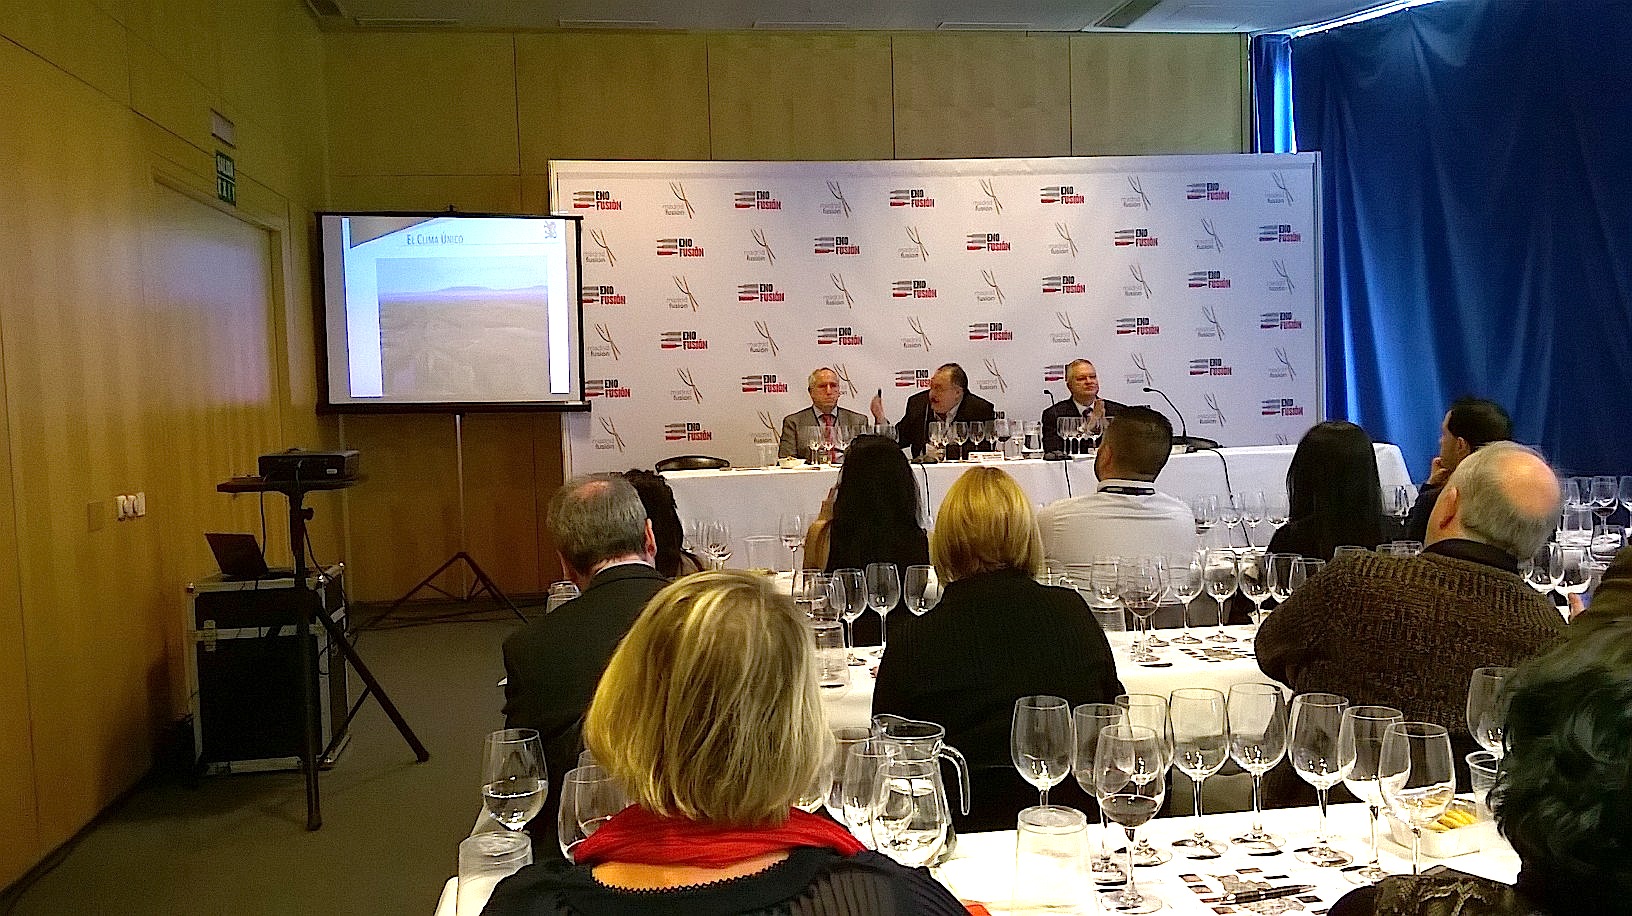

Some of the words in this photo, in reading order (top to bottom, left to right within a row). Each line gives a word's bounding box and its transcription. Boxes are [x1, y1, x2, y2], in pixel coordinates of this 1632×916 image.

[1061, 187, 1074, 195] ENO
[1207, 183, 1219, 191] ENO
[596, 191, 610, 200] ENO
[757, 191, 770, 200] ENO
[911, 190, 924, 198] ENO
[1207, 190, 1230, 200] FUSIÓN
[911, 197, 934, 208] FUSIÓN
[1061, 194, 1084, 204] FUSIÓN
[596, 199, 622, 210] FUSIÓN
[757, 199, 781, 210] FUSIÓN
[1136, 229, 1148, 237] ENO
[1279, 225, 1291, 233] ENO
[836, 237, 849, 245] ENO
[987, 234, 1000, 242] ENO
[1279, 232, 1301, 242] FUSIÓN
[679, 239, 693, 247] ENO
[987, 241, 1011, 251] FUSIÓN
[1136, 237, 1158, 247] FUSIÓN
[680, 246, 704, 257] FUSIÓN
[836, 244, 860, 254] FUSIÓN
[1208, 271, 1220, 279] ENO
[1063, 276, 1075, 284] ENO
[1208, 278, 1231, 288] FUSIÓN
[760, 284, 773, 292] ENO
[913, 281, 926, 289] ENO
[1063, 283, 1086, 294] FUSIÓN
[600, 286, 614, 295] ENO
[914, 288, 937, 298] FUSIÓN
[600, 294, 626, 305] FUSIÓN
[760, 291, 785, 302] FUSIÓN
[1280, 312, 1292, 320] ENO
[1137, 318, 1149, 326] ENO
[1280, 320, 1301, 329] FUSIÓN
[990, 323, 1003, 331] ENO
[1136, 325, 1160, 335] FUSIÓN
[683, 332, 696, 340] ENO
[839, 328, 852, 336] ENO
[990, 330, 1013, 340] FUSIÓN
[683, 339, 708, 350] FUSIÓN
[839, 335, 863, 345] FUSIÓN
[916, 370, 929, 378] ENO
[1210, 366, 1232, 376] FUSIÓN
[763, 375, 776, 383] ENO
[916, 379, 930, 388] FUS
[605, 380, 618, 388] ENO
[763, 382, 788, 393] FUSIÓN
[605, 387, 630, 398] FUSIÓN
[1281, 399, 1293, 407] ENO
[1281, 406, 1303, 416] FUSIÓN
[687, 423, 700, 431] ENO
[687, 430, 712, 441] FUSIÓN
